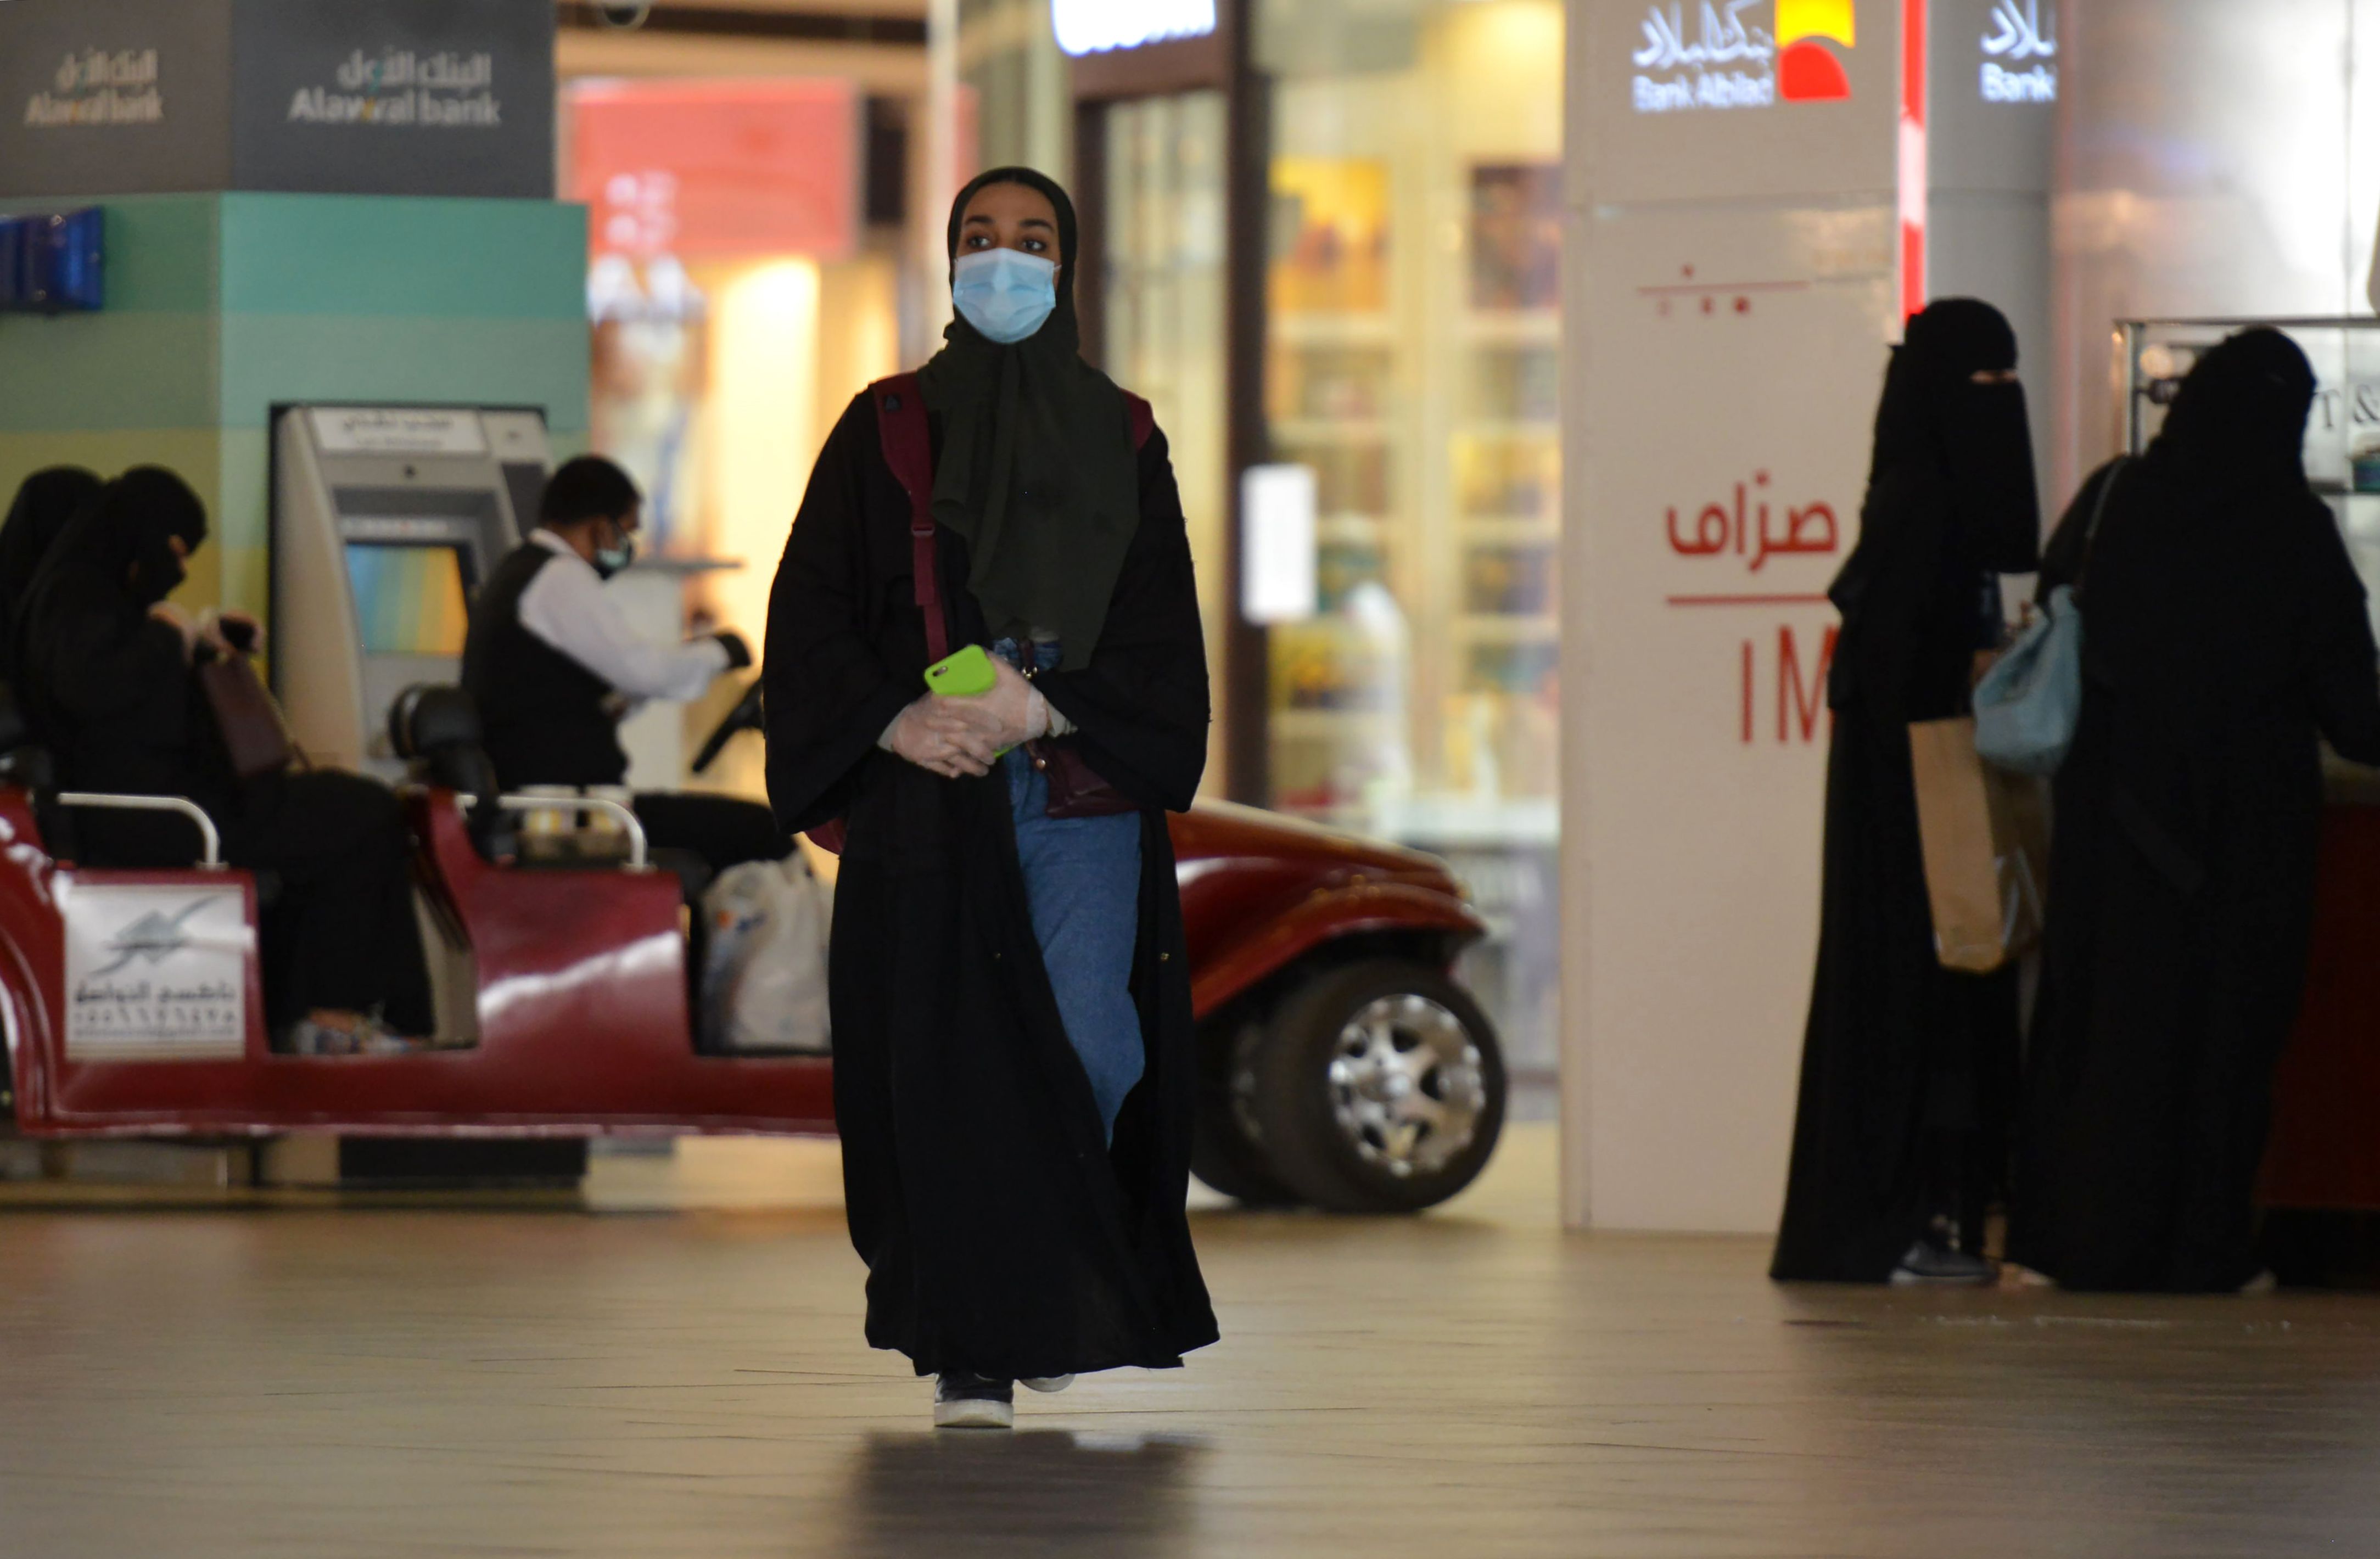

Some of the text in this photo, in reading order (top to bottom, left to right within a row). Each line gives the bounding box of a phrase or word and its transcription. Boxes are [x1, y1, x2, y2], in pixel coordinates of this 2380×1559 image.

[418, 50, 491, 96] البنك
[1632, 75, 1695, 111] Bank
[1980, 61, 2056, 103] Bank
[110, 86, 164, 125] bank
[417, 87, 502, 127] bank
